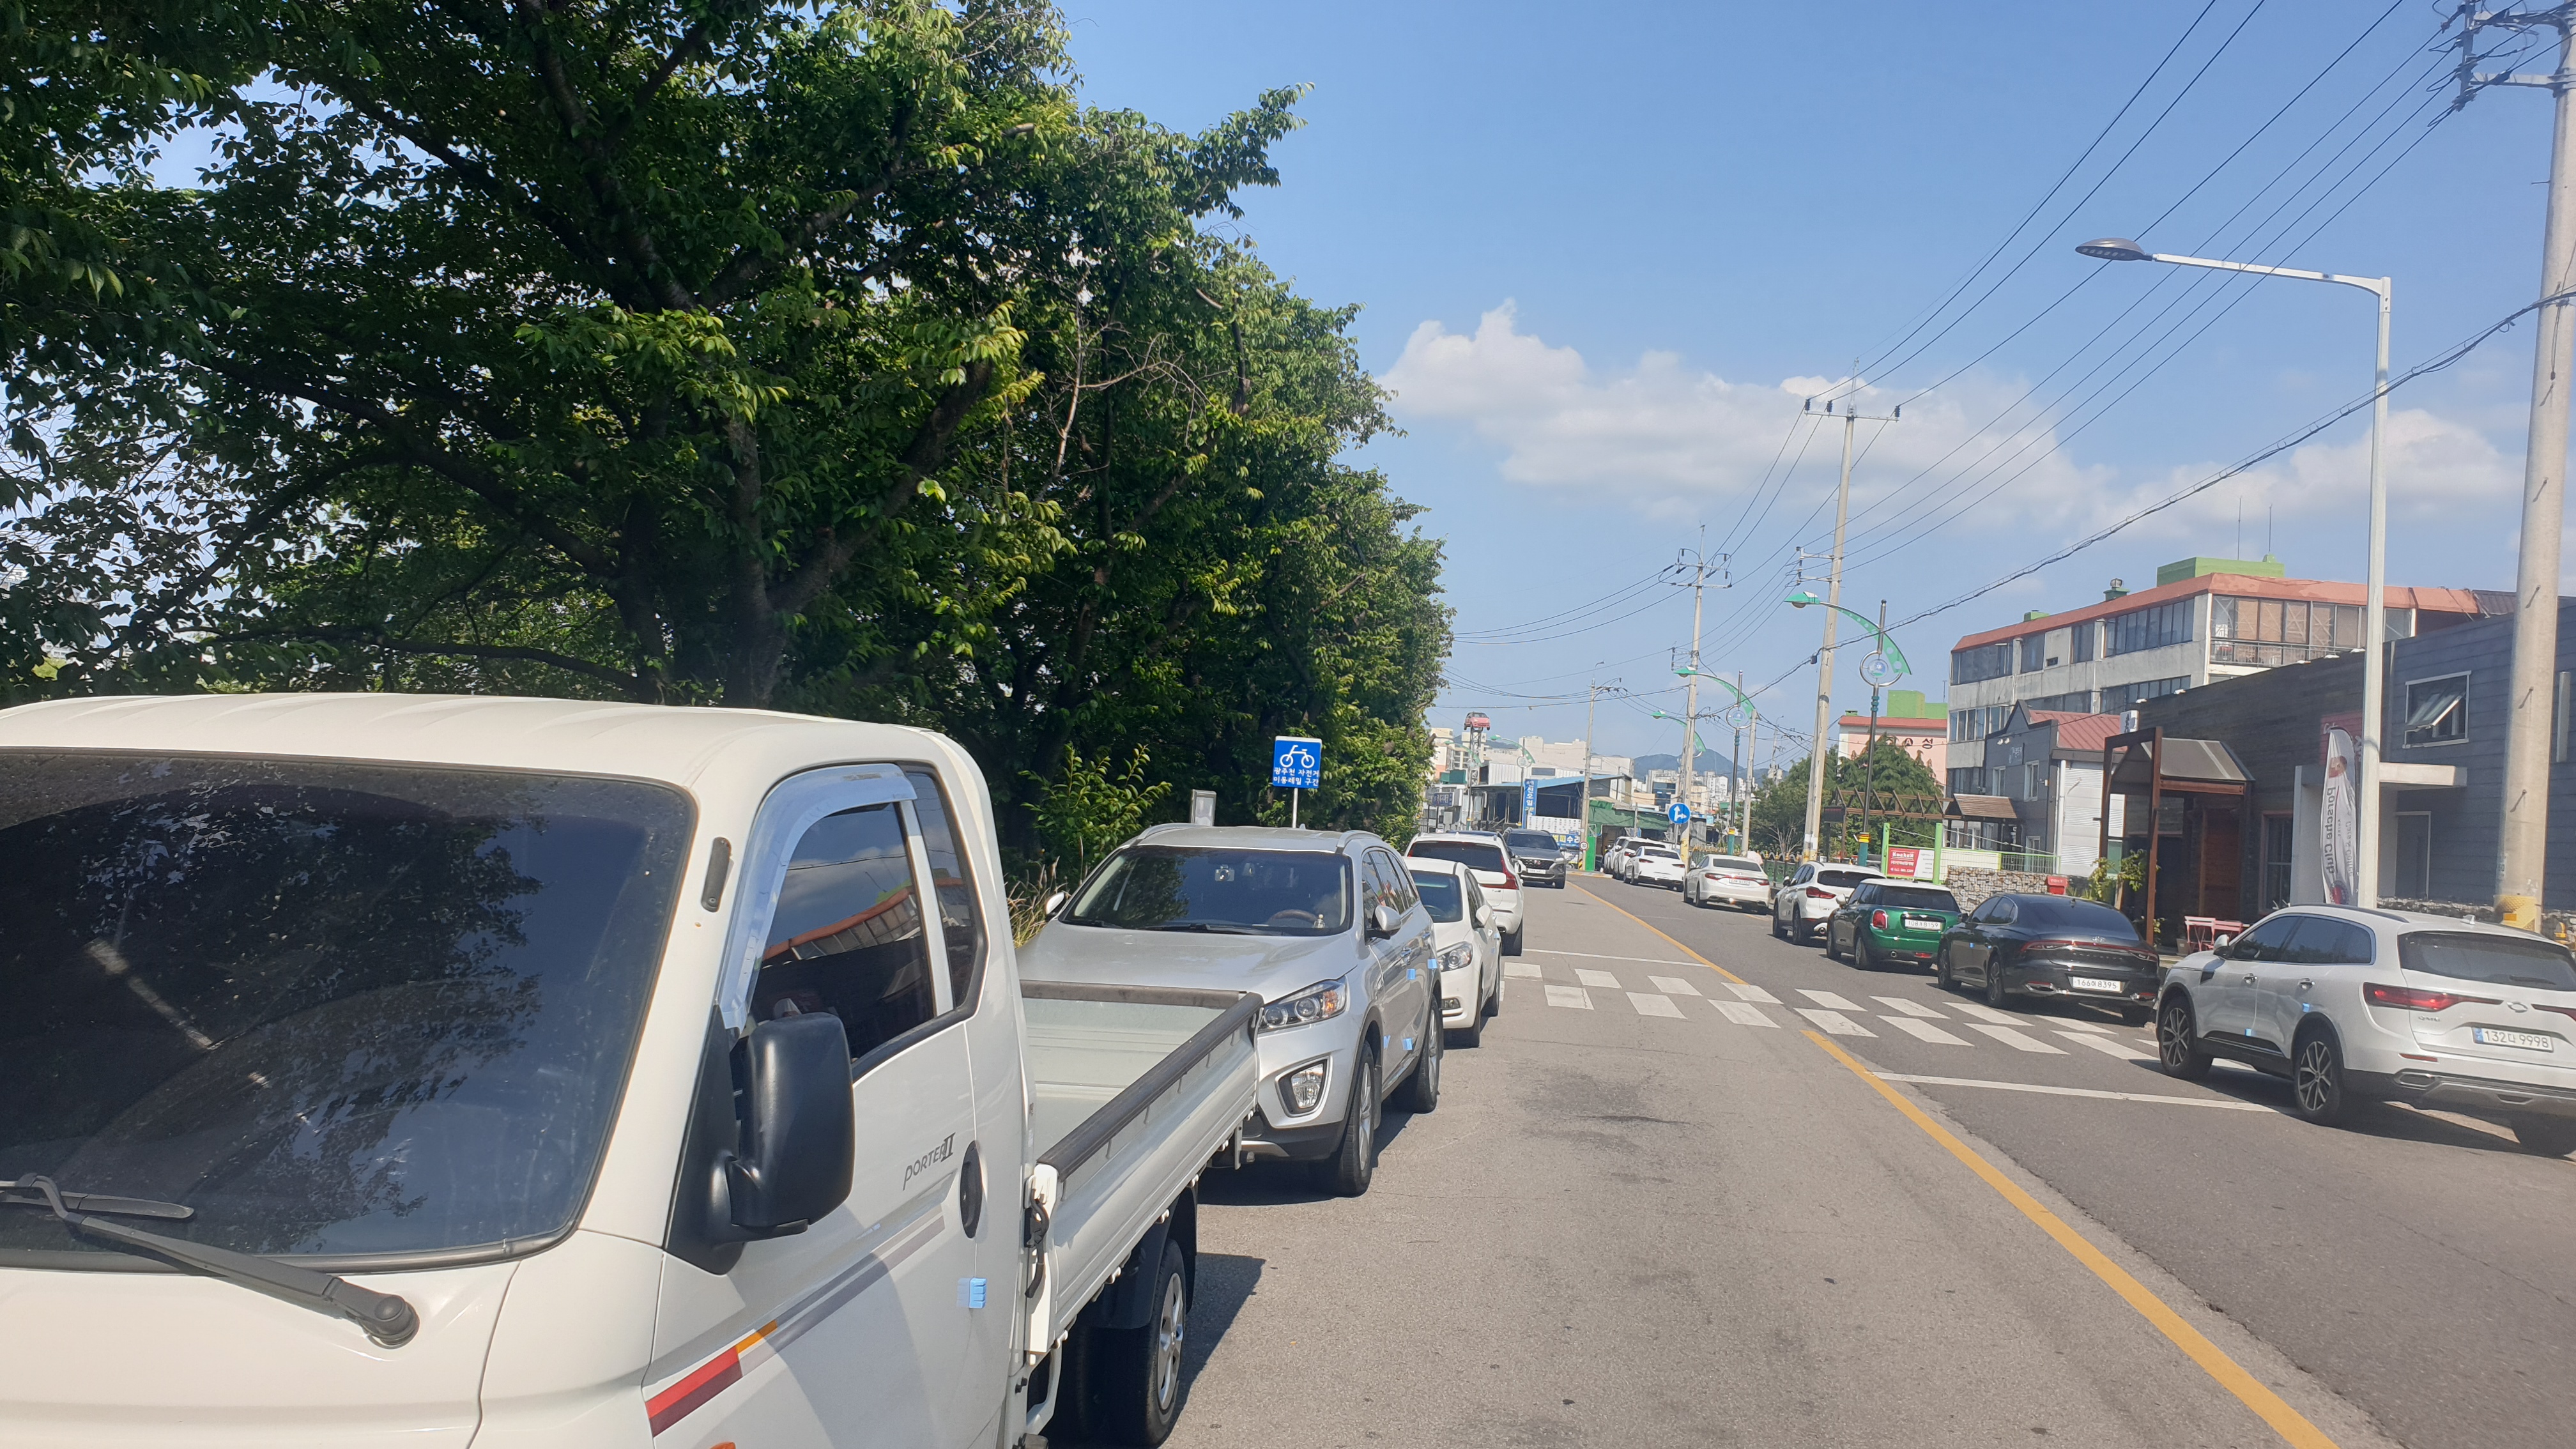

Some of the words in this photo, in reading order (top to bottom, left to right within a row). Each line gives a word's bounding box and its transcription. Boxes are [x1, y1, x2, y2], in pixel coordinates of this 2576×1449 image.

[1922, 738, 1933, 749] 성
[1273, 767, 1296, 776] 광주천
[1298, 769, 1319, 778] 자전거
[1305, 778, 1319, 786] 구간
